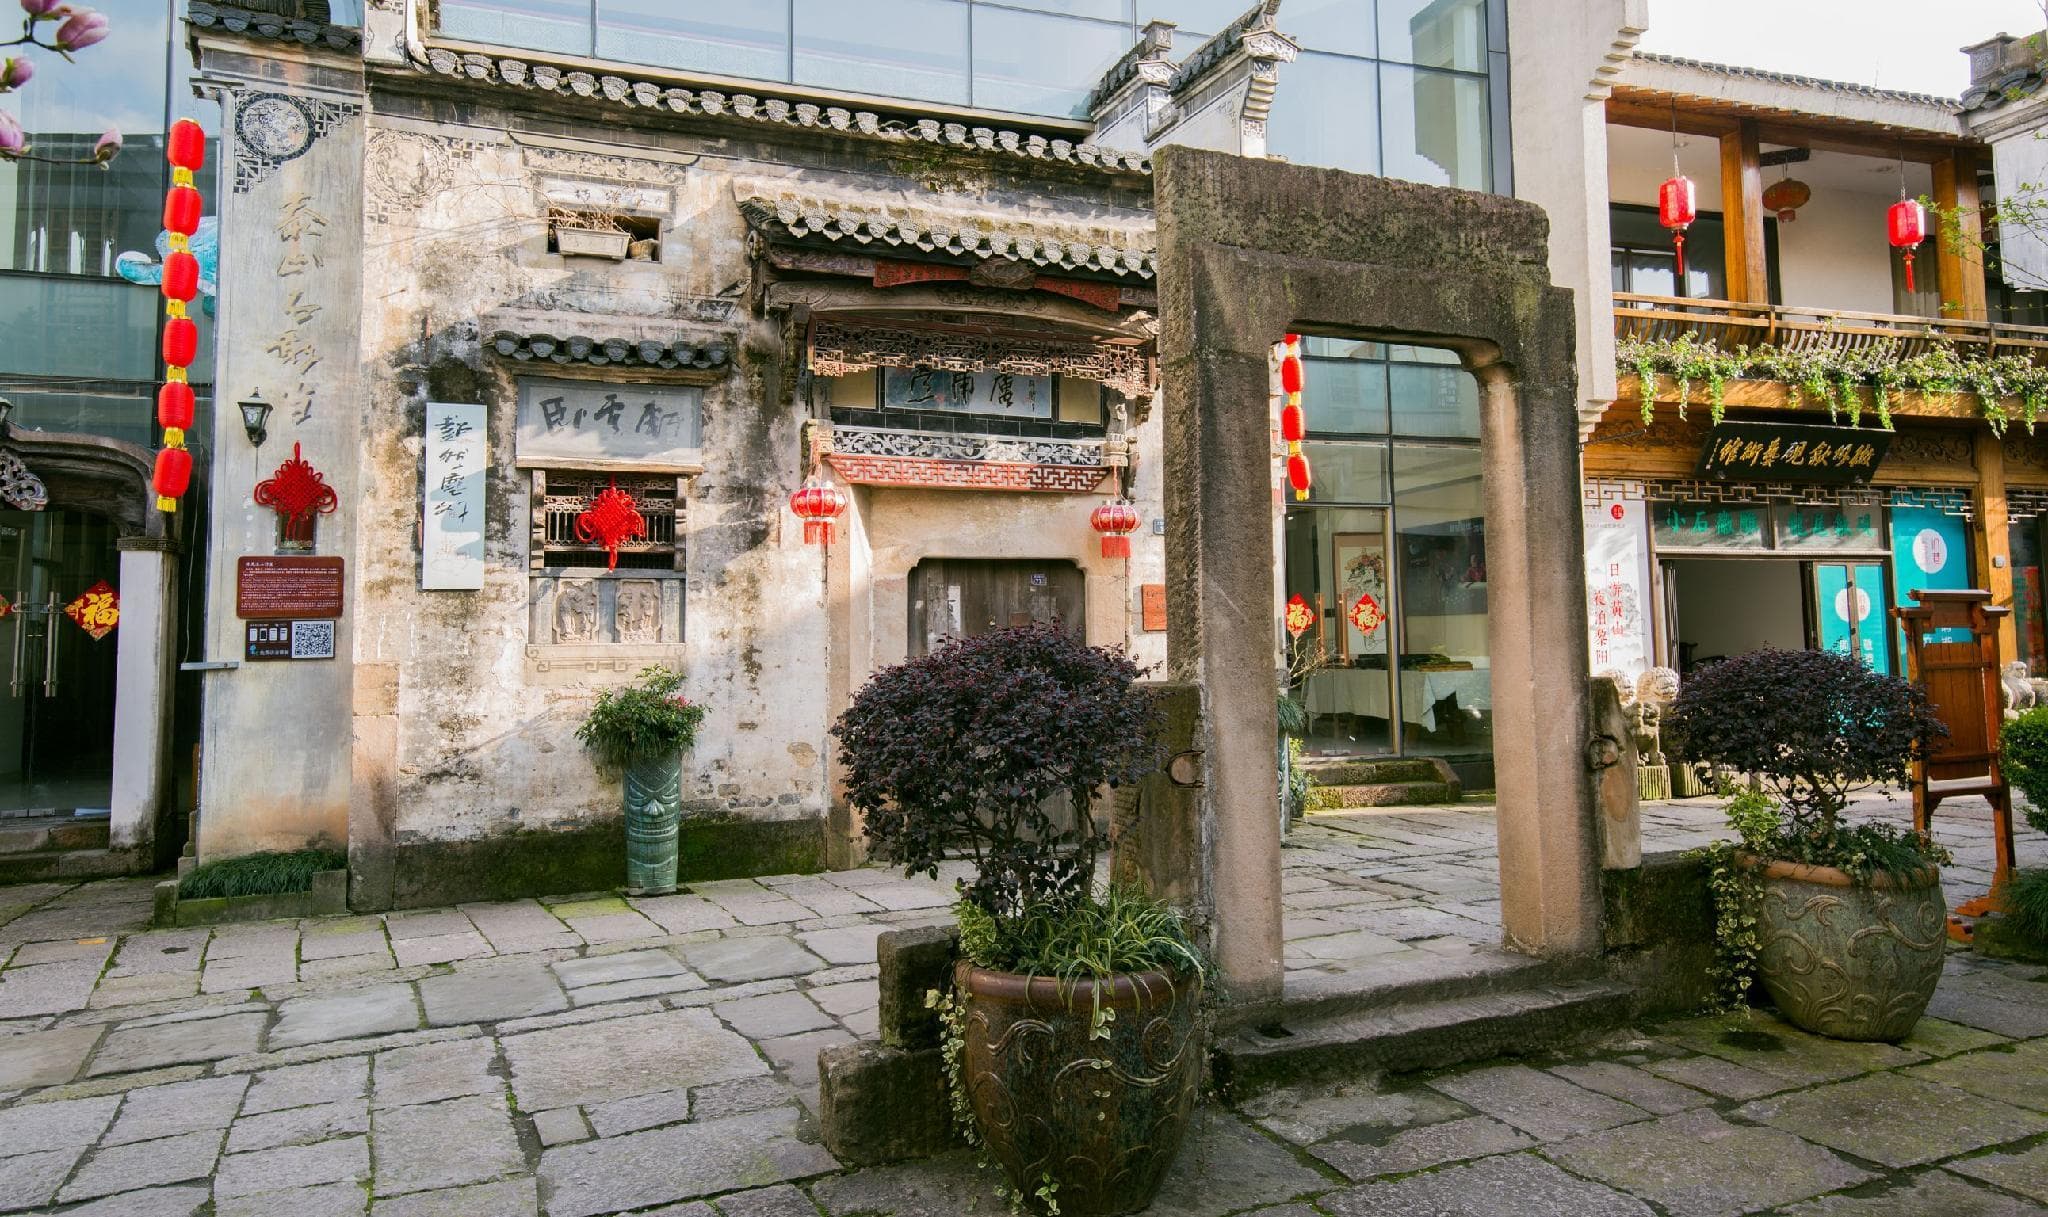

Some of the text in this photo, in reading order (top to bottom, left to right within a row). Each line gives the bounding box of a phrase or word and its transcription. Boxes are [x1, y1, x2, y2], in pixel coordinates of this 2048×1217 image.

[86, 593, 119, 625] 福
[1287, 603, 1309, 629] 福
[1357, 603, 1378, 629] 福
